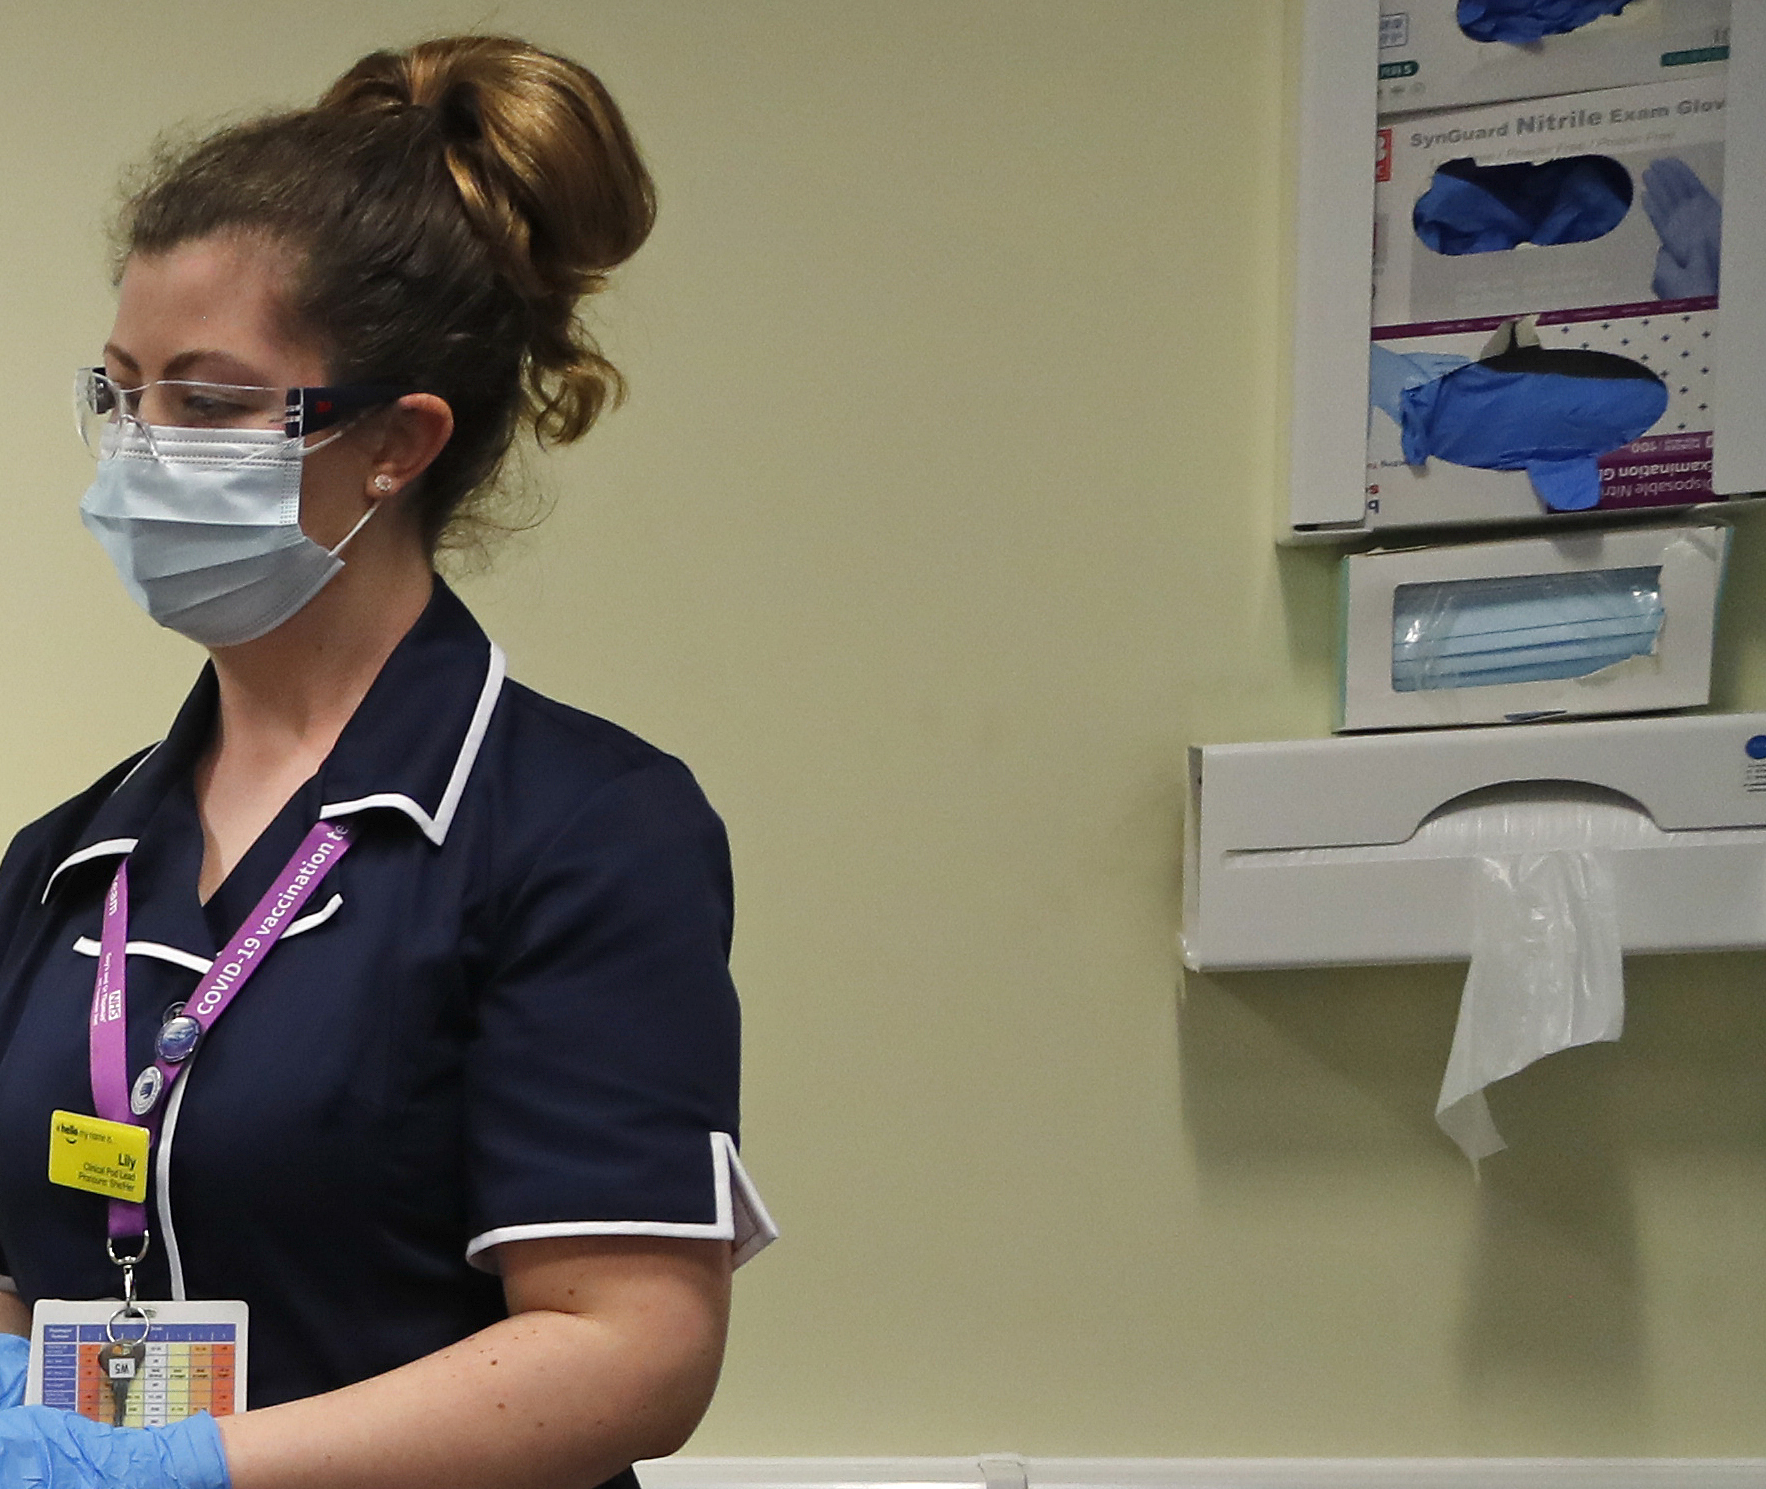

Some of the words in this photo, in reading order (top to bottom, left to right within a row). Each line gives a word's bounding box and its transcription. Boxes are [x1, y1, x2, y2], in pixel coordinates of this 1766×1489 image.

[1410, 121, 1508, 149] SynGuard
[1517, 110, 1603, 137] Nitrile
[1610, 104, 1669, 125] Exam
[197, 936, 262, 1017] COVID-19
[256, 842, 335, 937] vaccination
[109, 991, 120, 1019] NHS
[118, 1153, 137, 1171] Lily
